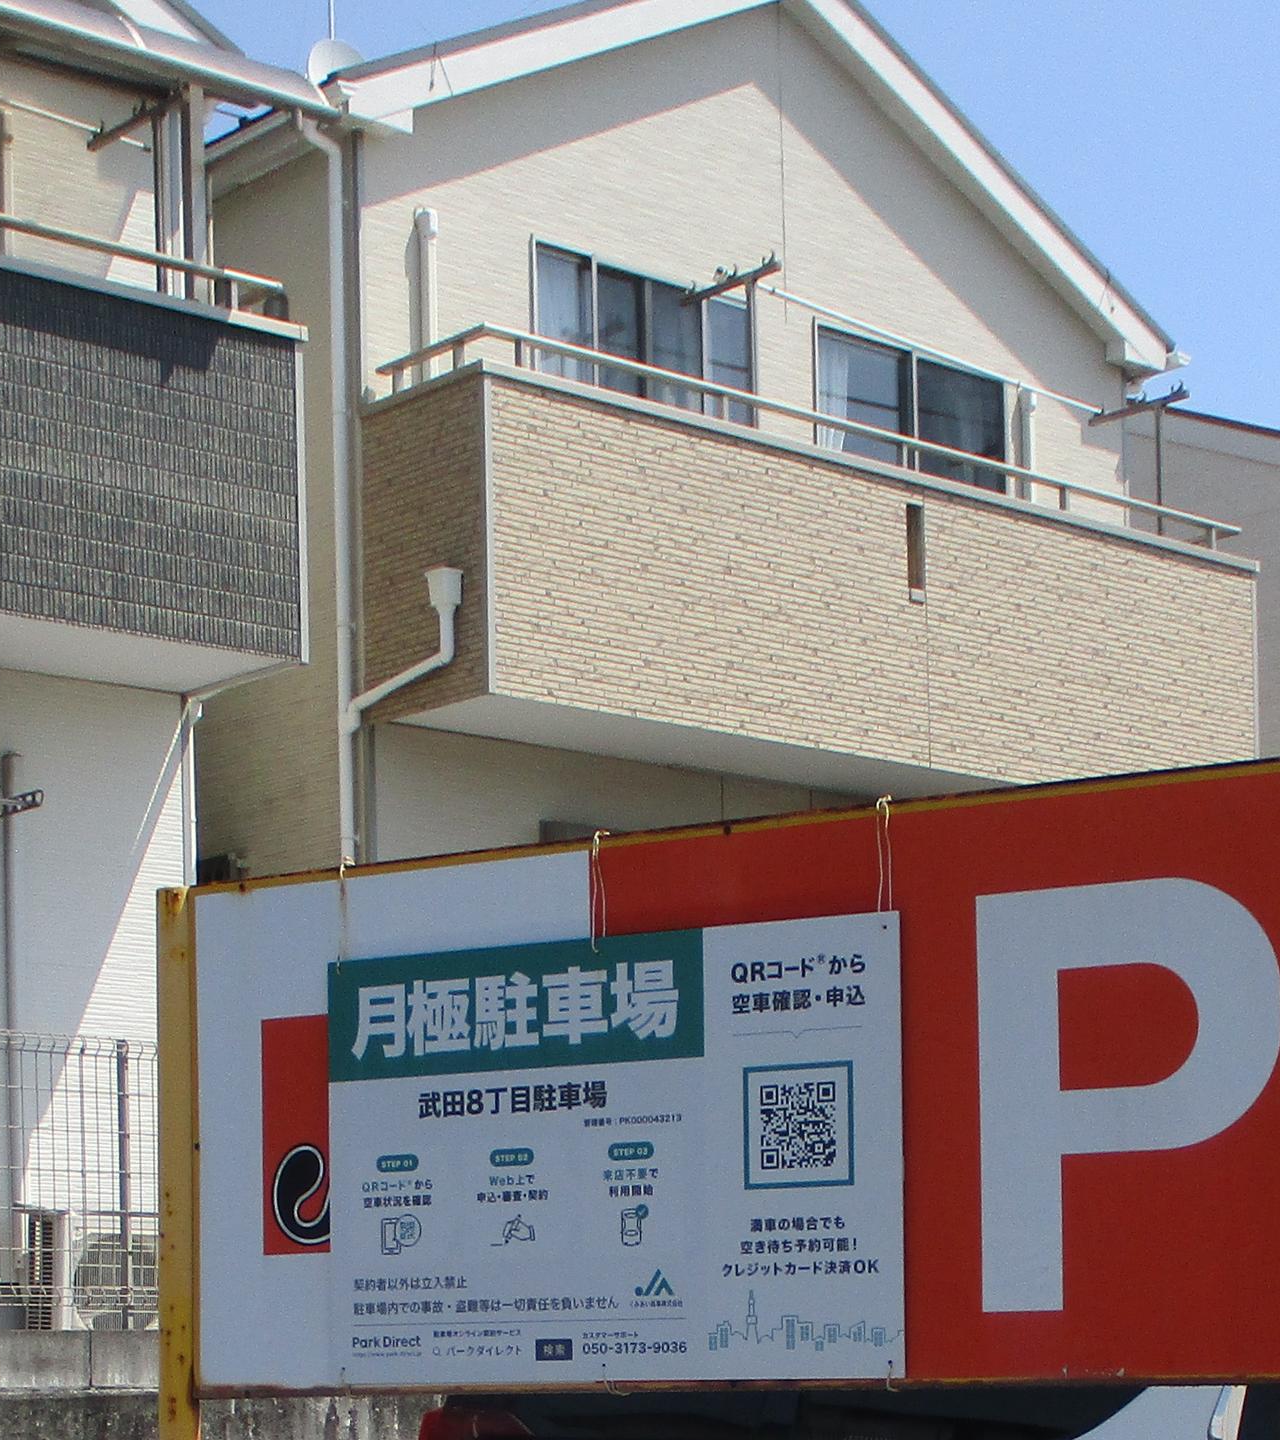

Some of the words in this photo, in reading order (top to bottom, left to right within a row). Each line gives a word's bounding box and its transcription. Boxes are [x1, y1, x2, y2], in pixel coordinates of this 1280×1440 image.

[732, 985, 866, 1014] 空車確認・申込
[351, 960, 679, 1061] 月極駐車場
[418, 1081, 607, 1119] 武田8丁目駐車場
[489, 1174, 535, 1186] Web上で
[603, 1168, 659, 1181] 来店不要で
[609, 1184, 654, 1198] 利用開始
[363, 1194, 432, 1209] 空車状況を確認
[750, 1216, 846, 1233] 満車の場合でも
[722, 1259, 880, 1277] クレジットカード決済OK
[353, 1275, 468, 1292] 契約者以外は立入禁止
[352, 1337, 381, 1349] Park
[383, 1335, 422, 1348] Direct
[582, 1341, 688, 1355] 050-3173-9036
[446, 1344, 522, 1357] パークダイレクト
